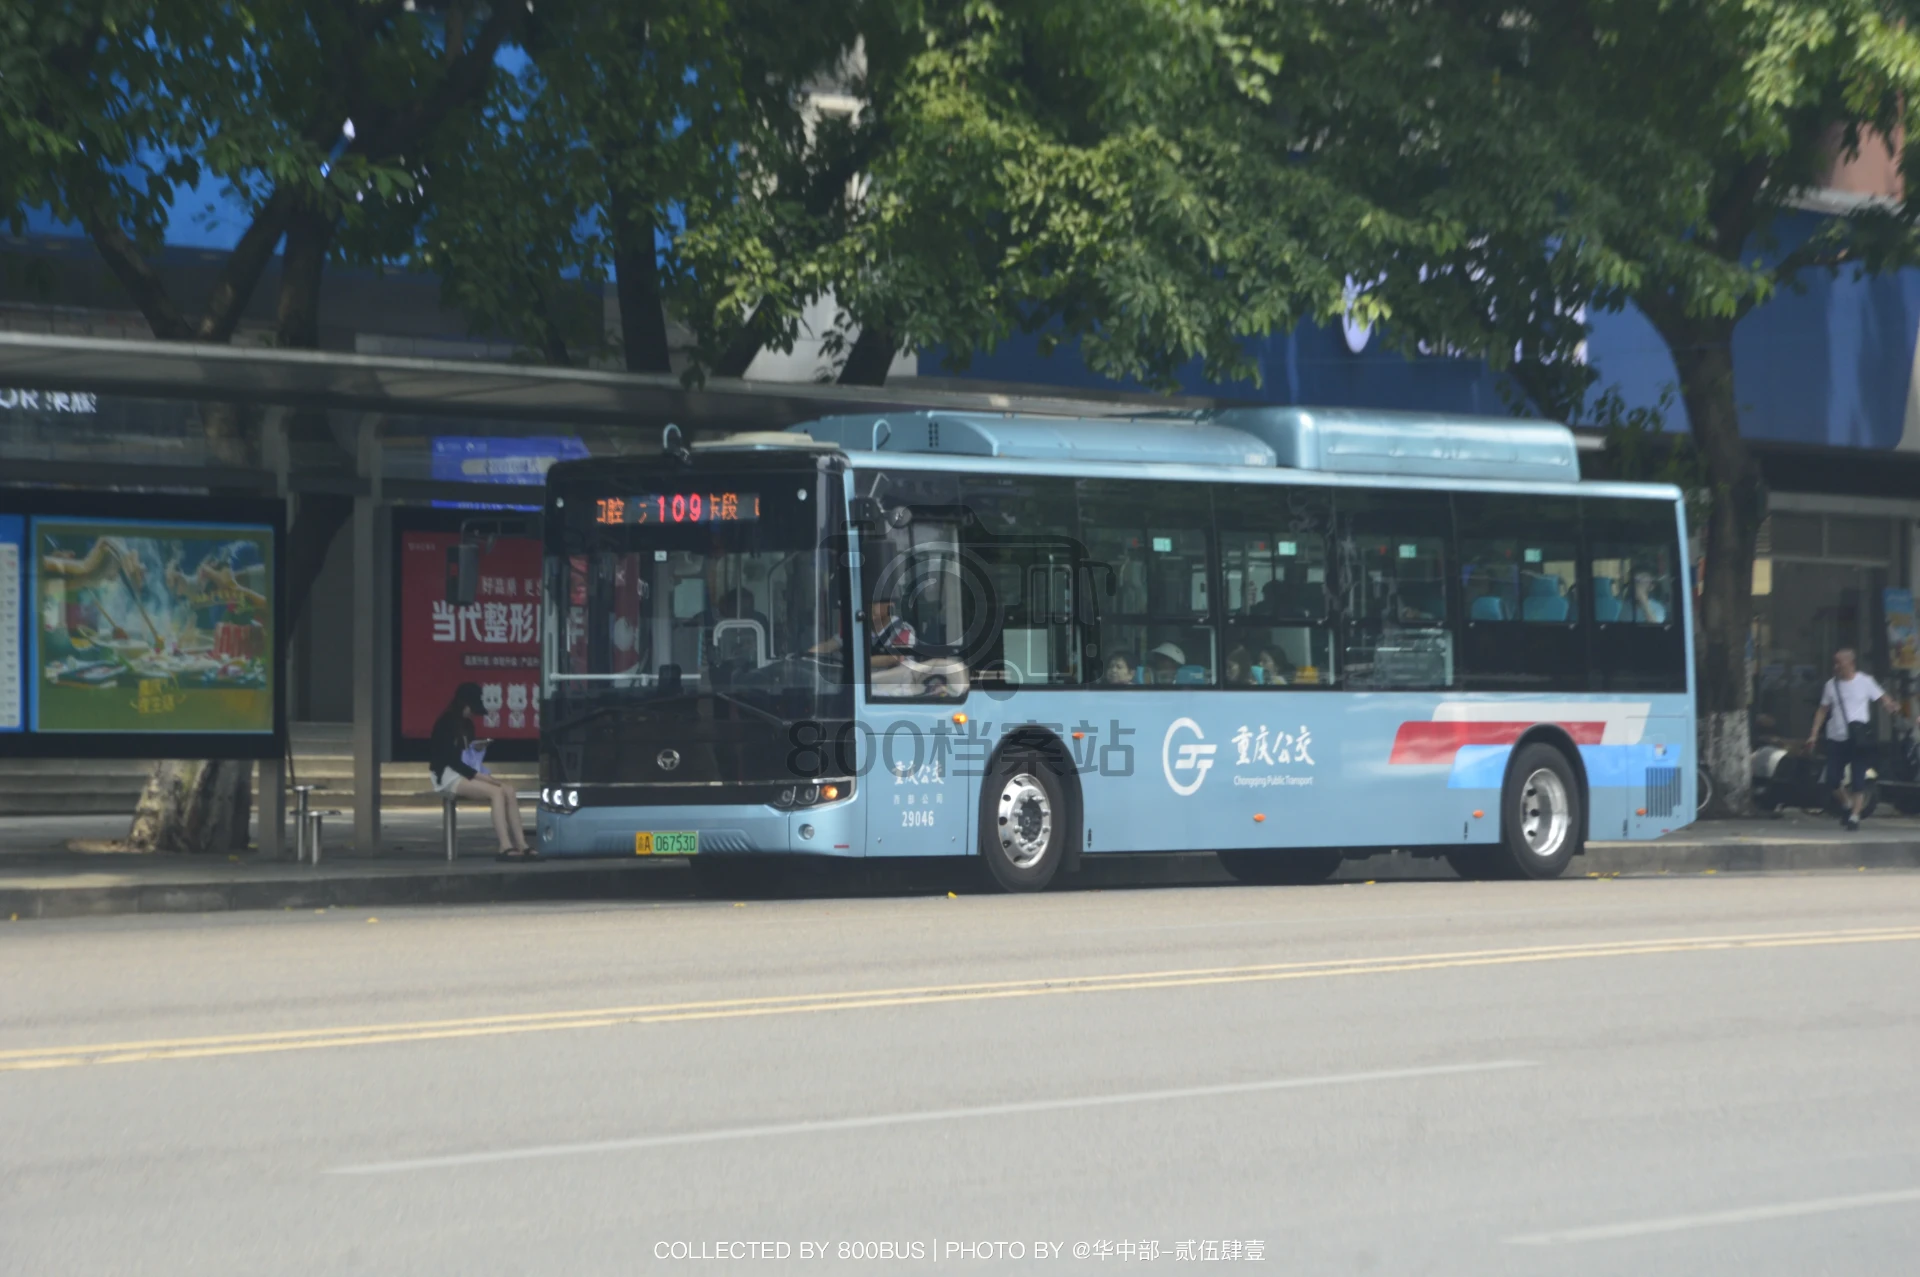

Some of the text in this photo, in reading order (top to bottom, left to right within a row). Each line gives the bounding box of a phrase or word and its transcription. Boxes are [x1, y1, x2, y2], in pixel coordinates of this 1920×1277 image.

[658, 493, 702, 523] 109
[432, 600, 541, 643] 当代整形
[1231, 724, 1315, 766] 重庆公交
[902, 810, 934, 827] 29046
